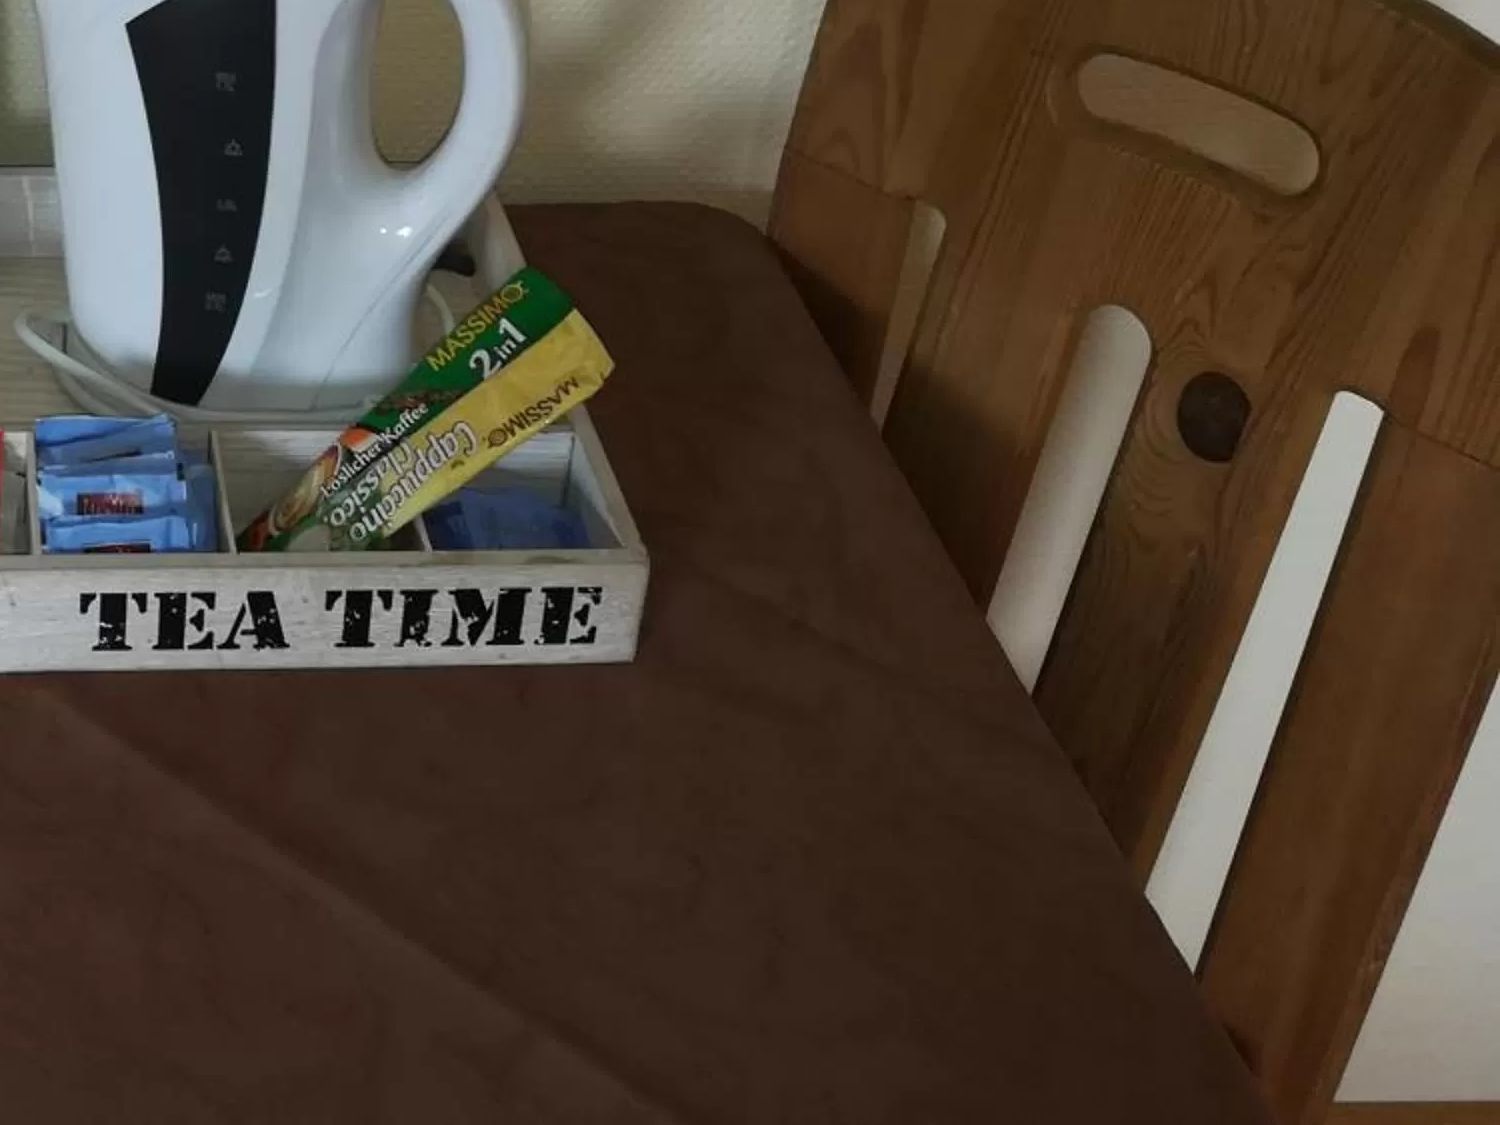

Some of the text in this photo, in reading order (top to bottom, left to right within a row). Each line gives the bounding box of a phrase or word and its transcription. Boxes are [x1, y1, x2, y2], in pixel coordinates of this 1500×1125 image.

[426, 279, 530, 372] MASSIMO
[349, 420, 478, 542] Cappuccino
[79, 586, 603, 651] TEA TIME
